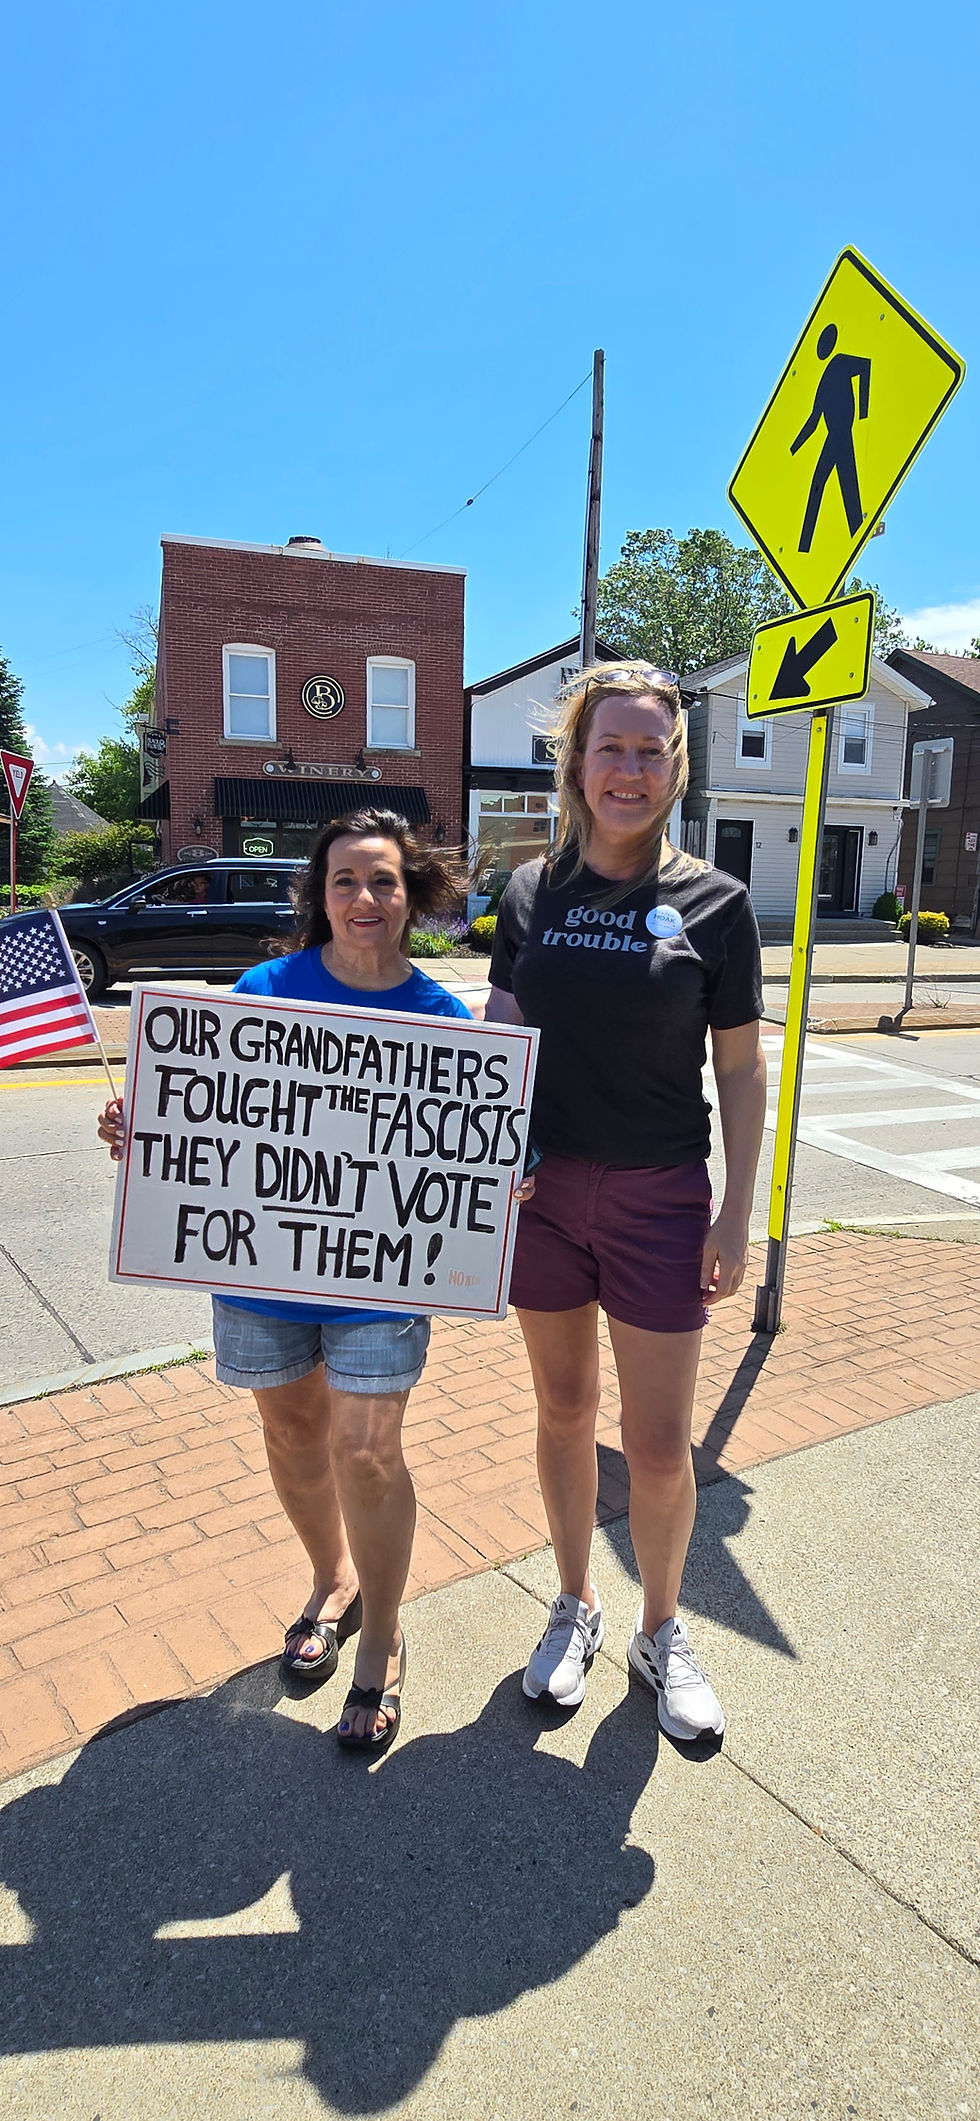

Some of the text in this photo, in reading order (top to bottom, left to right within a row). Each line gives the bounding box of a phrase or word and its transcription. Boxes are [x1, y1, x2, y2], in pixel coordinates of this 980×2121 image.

[278, 764, 369, 778] WINERY
[565, 905, 637, 931] good
[653, 914, 676, 924] HOAK
[541, 927, 648, 953] trouble
[145, 1006, 509, 1100] OUR GRANDFATHERS
[155, 1065, 526, 1167] FOUGHT THE FASCISTS
[134, 1132, 499, 1234] THEY DIDN'T VOTE
[174, 1204, 257, 1266] FOR
[449, 1269, 465, 1286] NO
